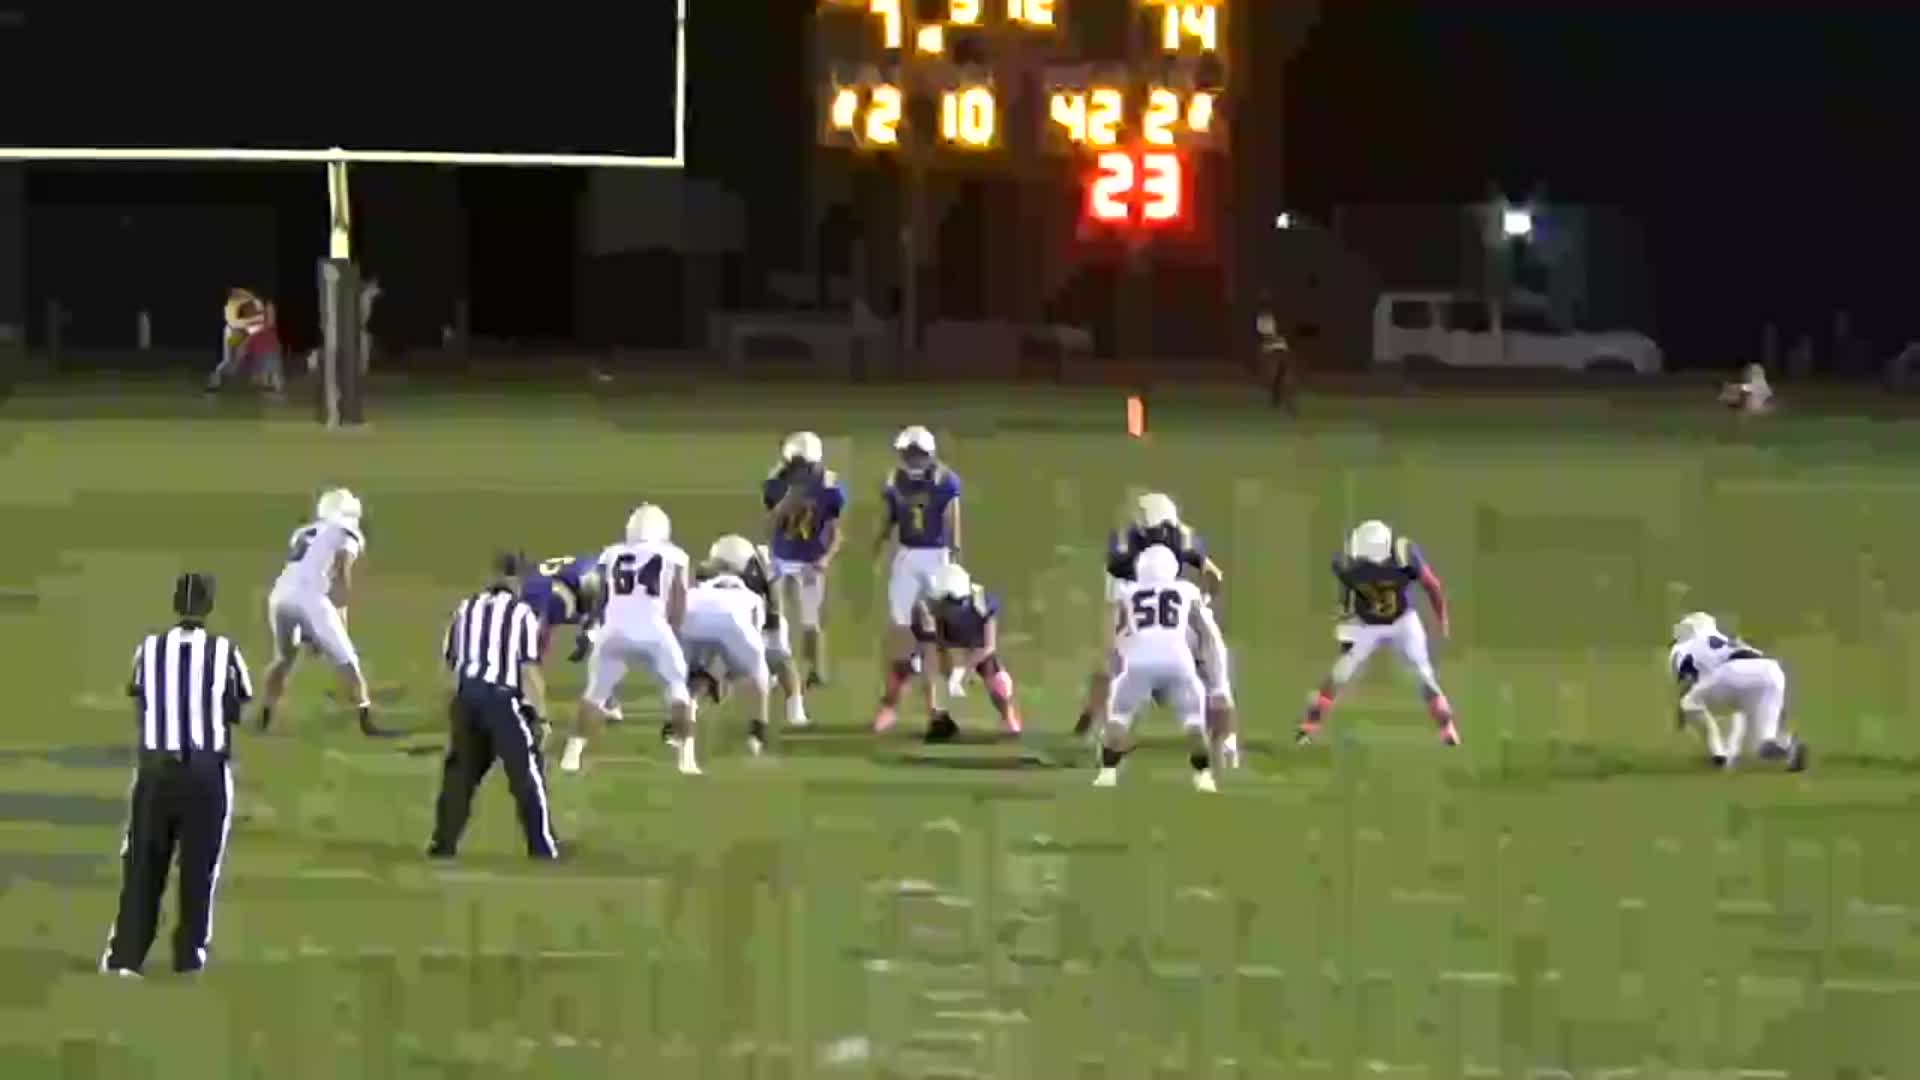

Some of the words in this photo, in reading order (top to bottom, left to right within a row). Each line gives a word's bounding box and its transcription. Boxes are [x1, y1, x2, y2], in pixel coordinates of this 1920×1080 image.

[1163, 0, 1216, 49] 14
[866, 86, 901, 144] 2
[943, 88, 994, 145] 10
[1051, 89, 1122, 144] 42
[1143, 88, 1178, 144] 2
[1092, 154, 1181, 218] 23
[613, 553, 663, 597] 64
[1131, 588, 1182, 629] 56
